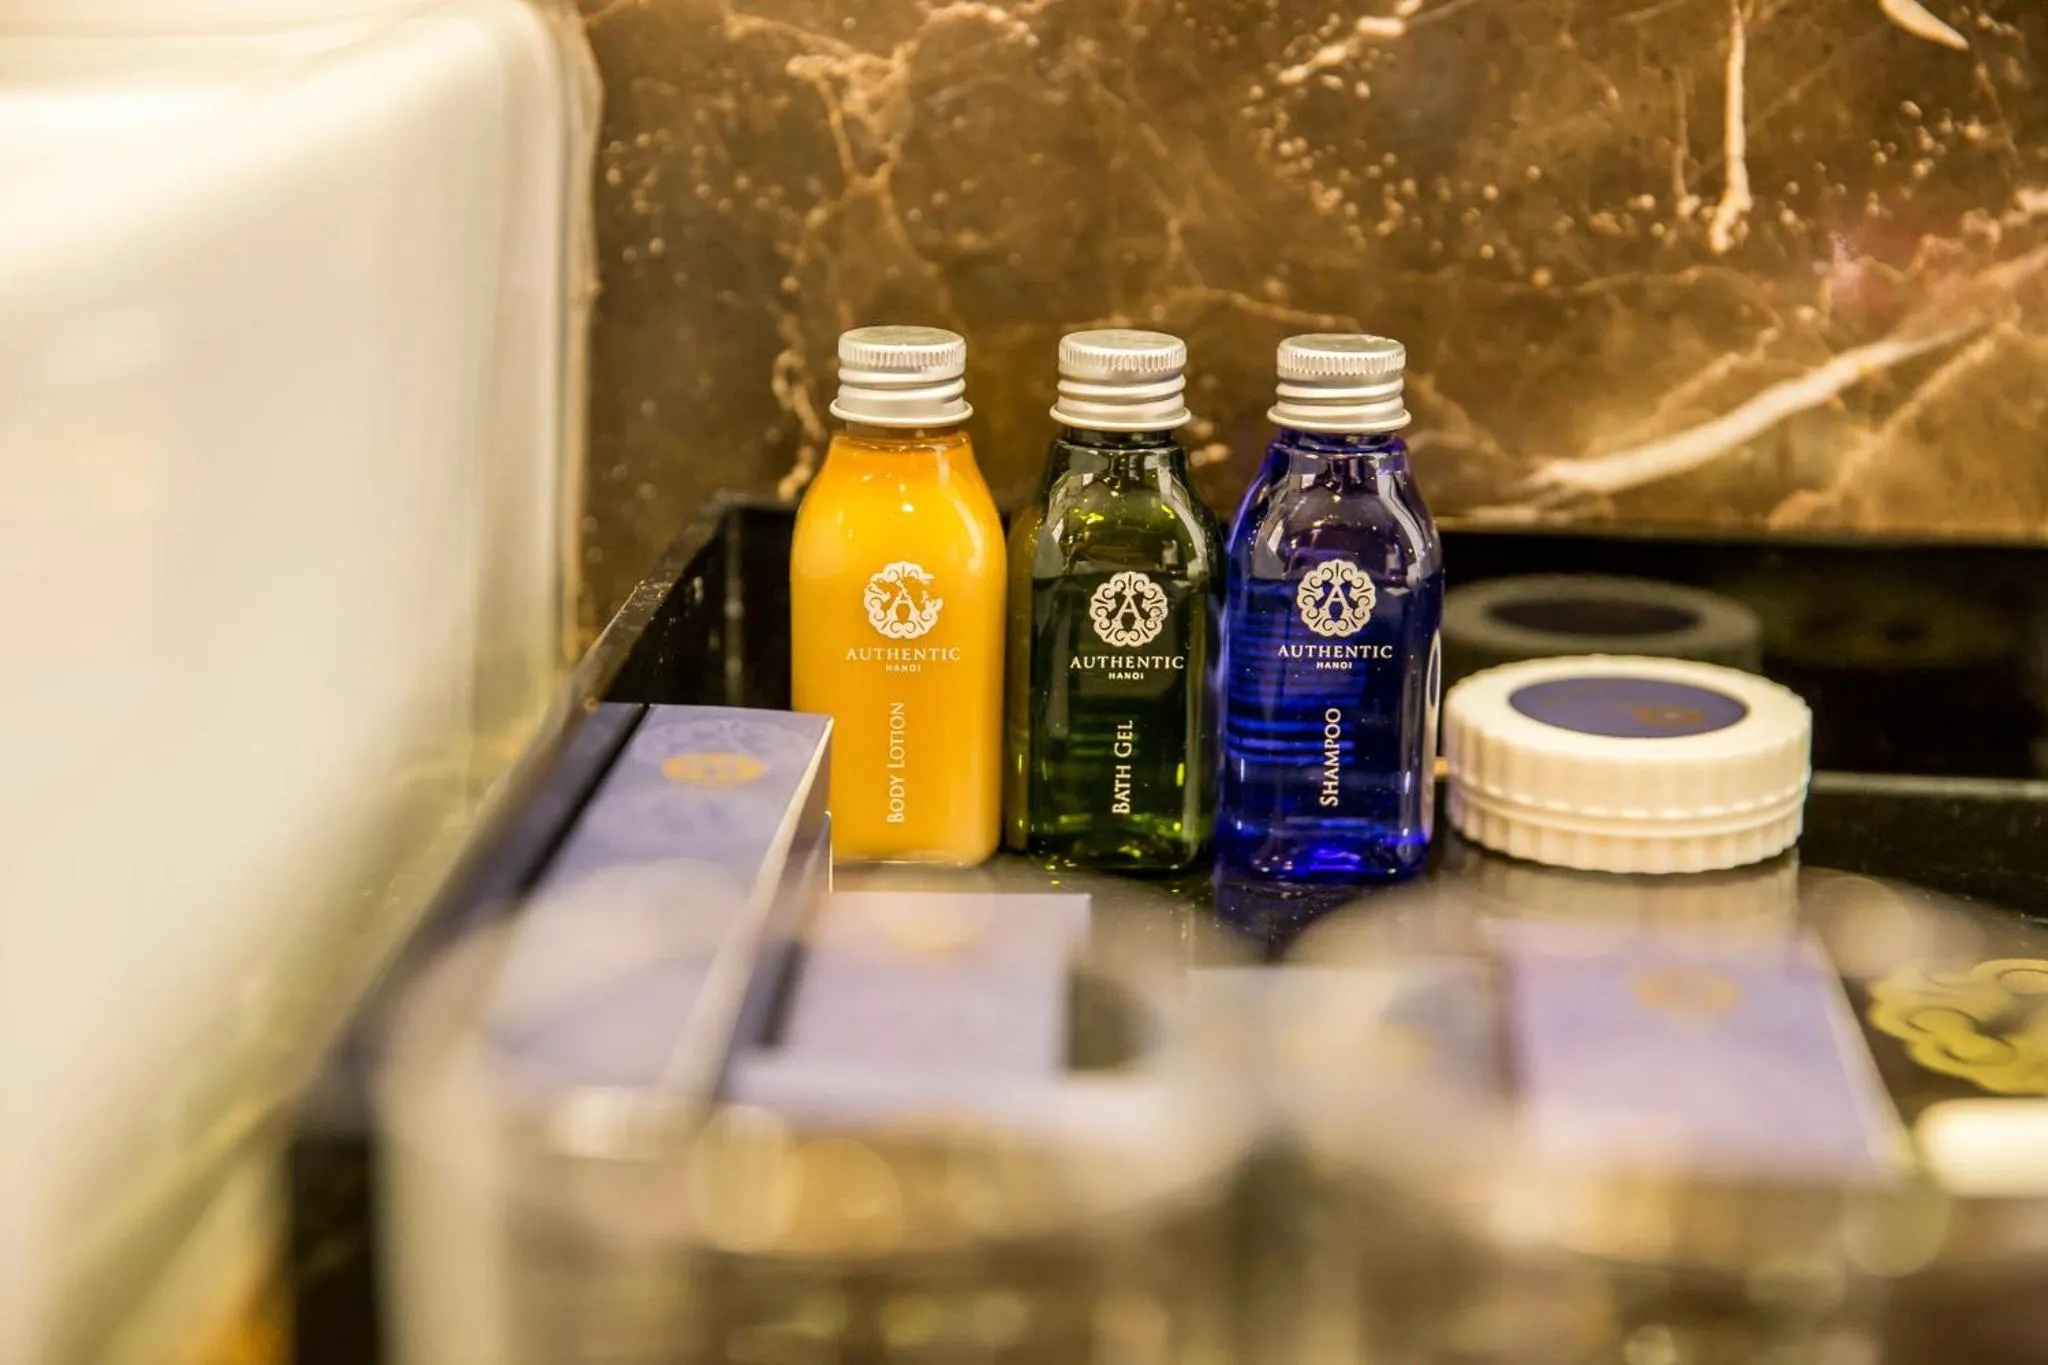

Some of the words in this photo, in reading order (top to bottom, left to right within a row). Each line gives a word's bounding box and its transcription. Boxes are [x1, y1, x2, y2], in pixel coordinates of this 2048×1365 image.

[846, 647, 960, 661] AUTHENTIC
[1278, 645, 1393, 658] AUTHENTIC
[885, 663, 921, 672] HANOI
[1070, 655, 1184, 669] AUTHENTIC
[1315, 661, 1352, 669] HANOI
[1108, 671, 1144, 680] HANOI
[886, 702, 905, 768] LOTION
[1113, 719, 1133, 758] GEL
[1319, 707, 1342, 807] SHAMPOO
[1111, 765, 1132, 814] BATH
[886, 775, 905, 823] BODY
